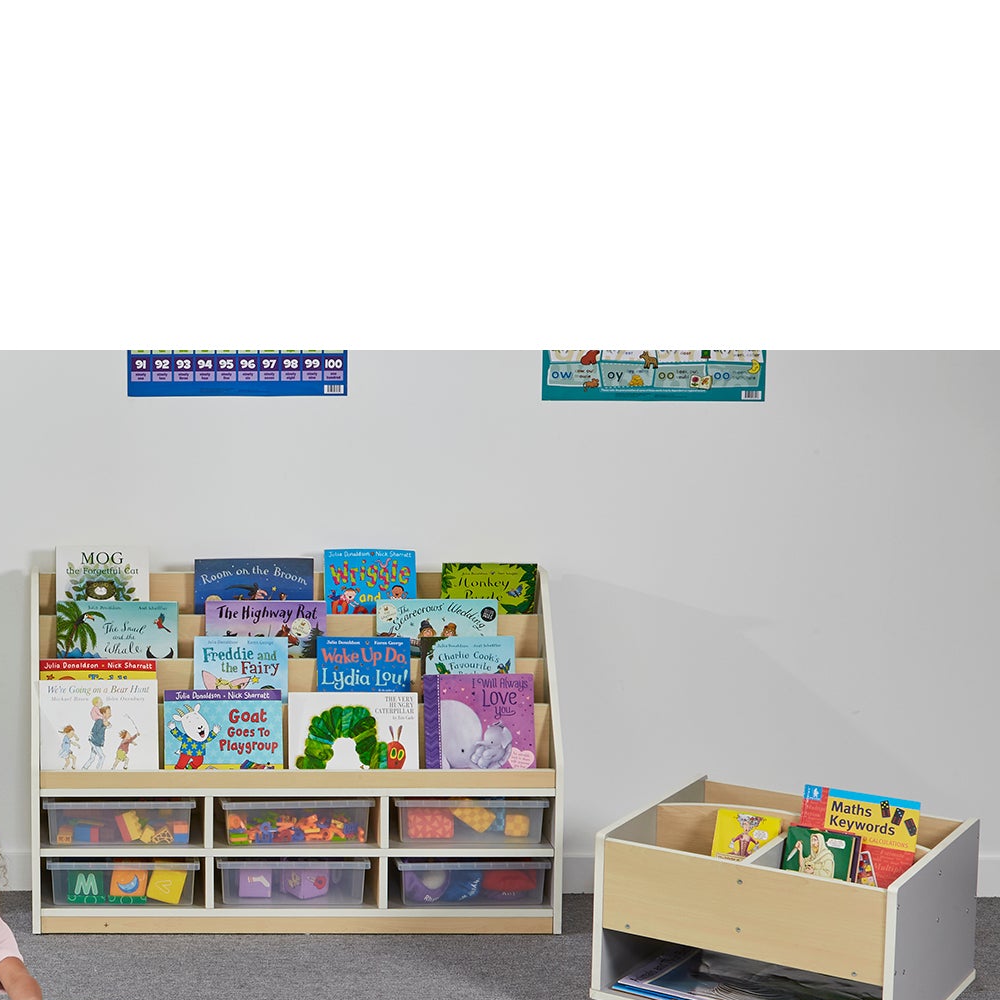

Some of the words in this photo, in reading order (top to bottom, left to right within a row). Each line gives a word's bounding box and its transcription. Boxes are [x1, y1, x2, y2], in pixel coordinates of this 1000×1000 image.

[135, 359, 146, 370] 91
[155, 359, 170, 370] 92
[176, 359, 191, 370] 93
[197, 359, 213, 370] 94
[219, 359, 234, 370] 95
[240, 359, 256, 369] 96
[262, 359, 277, 369] 97
[283, 359, 298, 369] 98
[304, 359, 320, 369] 99
[324, 359, 343, 369] 100
[552, 371, 572, 379] ow
[607, 371, 624, 382] oy
[658, 372, 674, 380] oo
[714, 372, 730, 380] oo
[81, 552, 123, 565] MOG
[83, 567, 121, 576] Forgetful
[124, 567, 139, 575] Cat
[201, 570, 234, 584] Room
[236, 568, 250, 576] on
[252, 566, 269, 575] the
[273, 566, 308, 586] Broom
[329, 560, 411, 590] Wriggle
[458, 577, 510, 591] Monkey
[359, 592, 381, 602] and
[217, 604, 239, 619] The
[242, 605, 293, 624] Highway
[296, 604, 317, 620] Rat
[447, 601, 486, 631] Wedding
[102, 622, 118, 634] The
[104, 641, 142, 654] Whale
[202, 647, 254, 662] Freddie
[257, 651, 277, 661] and
[321, 648, 360, 664] Wake
[361, 647, 382, 666] Up
[438, 651, 469, 662] Charlie
[473, 651, 500, 663] Cook's
[44, 662, 60, 670] Julia
[124, 662, 153, 670] Sharratt
[221, 661, 238, 673] the
[241, 661, 280, 676] Fairy
[448, 661, 492, 671] Favourite
[321, 668, 370, 690] Lydia
[375, 669, 408, 687] Lou!
[476, 678, 497, 688] Will
[500, 677, 528, 692] Always
[68, 686, 91, 695] Going
[110, 685, 128, 694] Bear
[130, 685, 150, 694] Hunt
[175, 692, 190, 700] Julia
[228, 708, 268, 724] Goat
[227, 727, 255, 737] Goes
[258, 727, 270, 737] To
[219, 739, 279, 755] Playgroup
[831, 800, 872, 818] Maths
[829, 815, 896, 836] Keywords
[870, 837, 909, 848] CALCULATIONS
